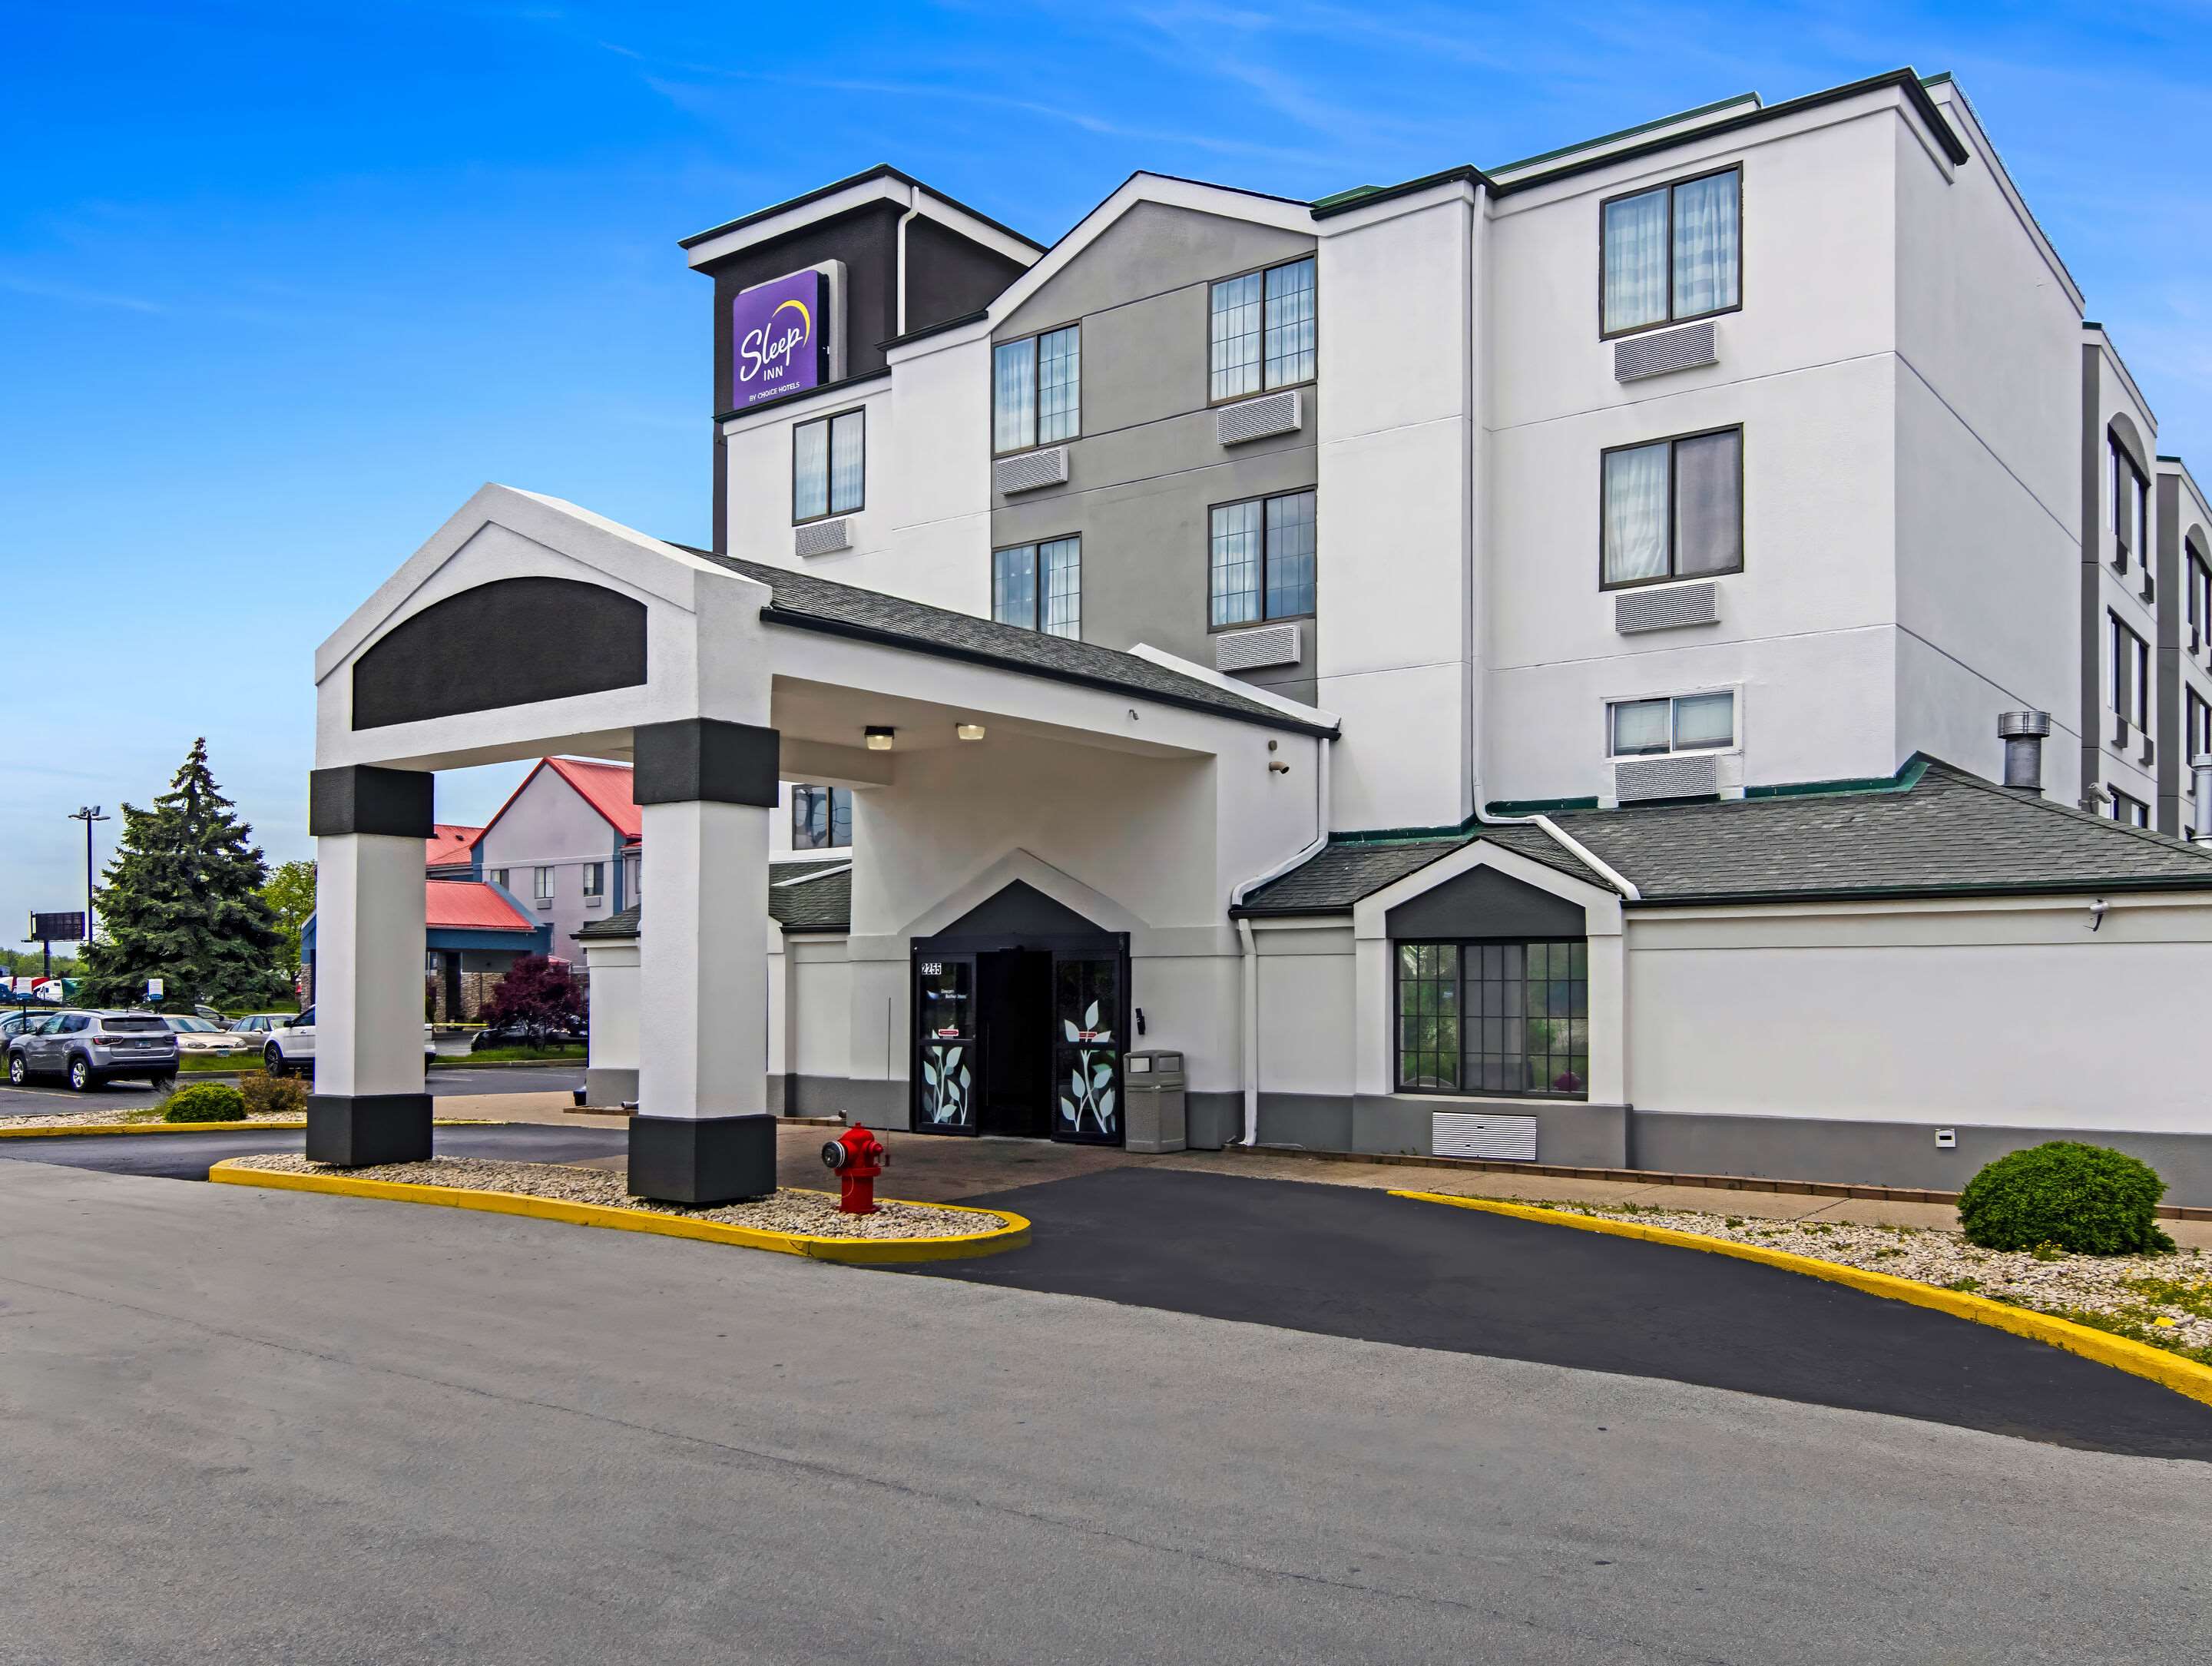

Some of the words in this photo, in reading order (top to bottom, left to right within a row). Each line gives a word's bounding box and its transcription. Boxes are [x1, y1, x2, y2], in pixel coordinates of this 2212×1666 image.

[740, 323, 803, 381] Sleep
[763, 365, 783, 381] INN
[757, 388, 778, 399] CHOICE
[778, 382, 800, 393] HOTELS
[921, 962, 942, 975] 2255
